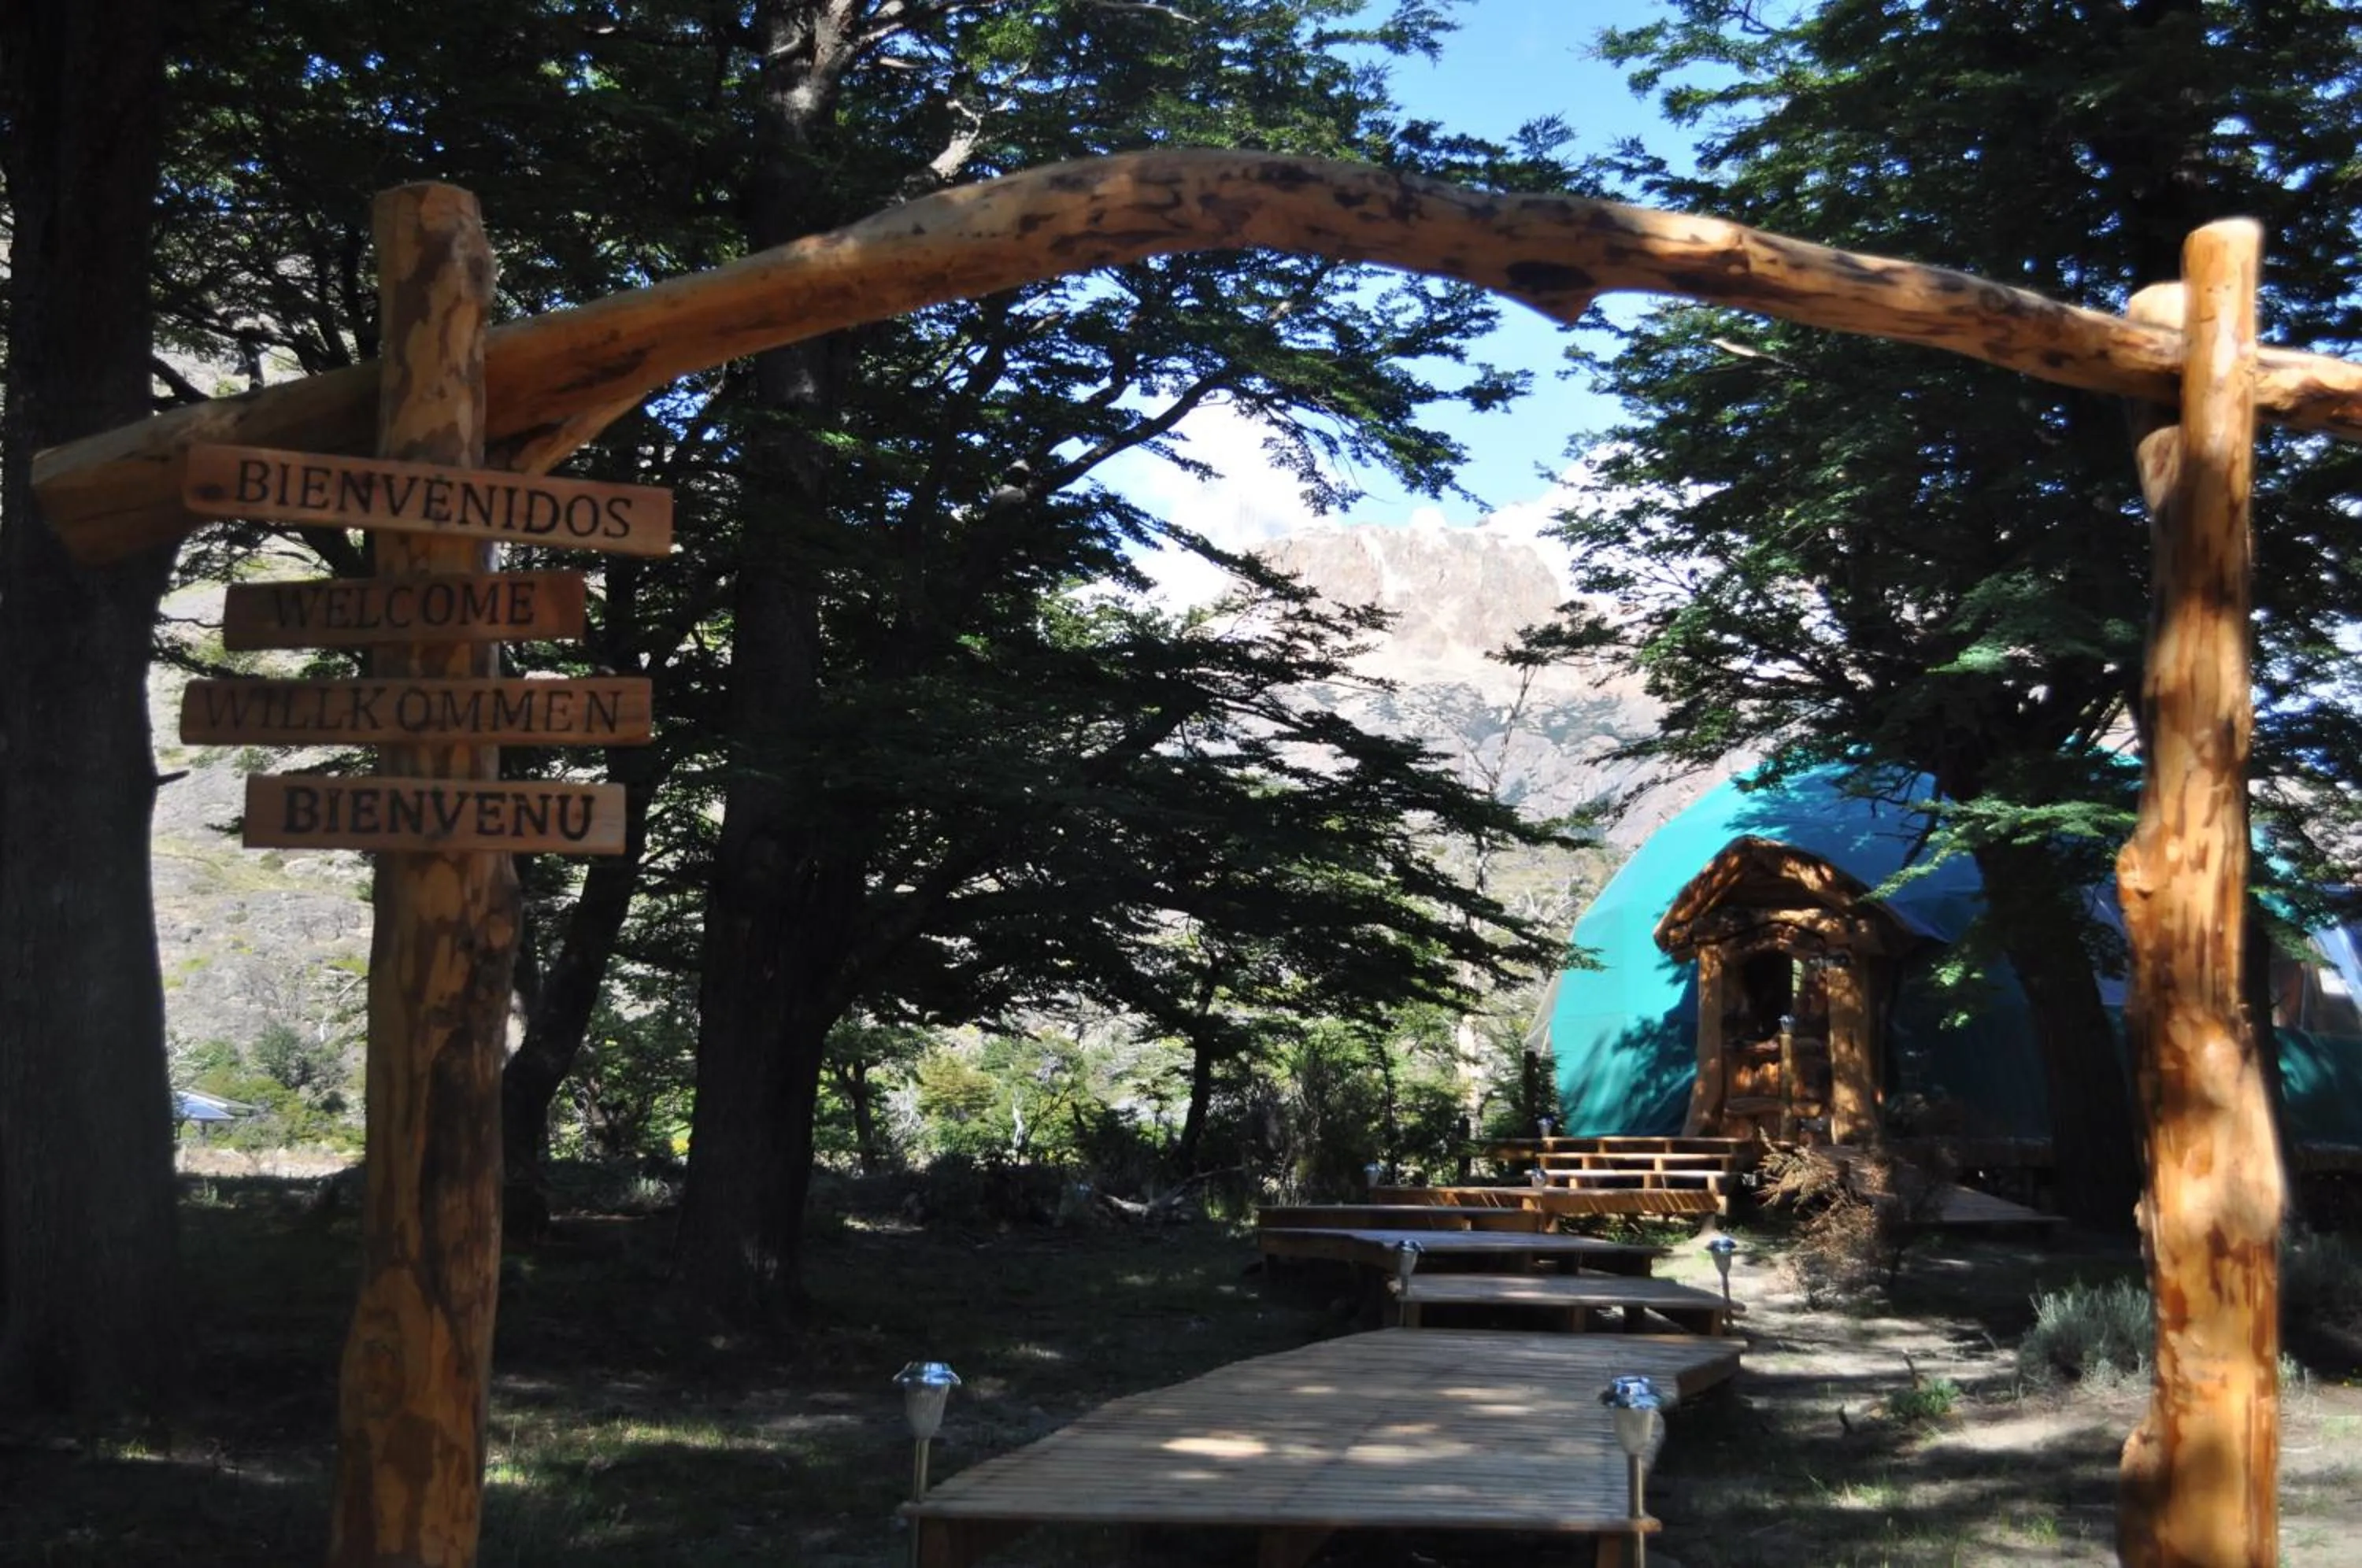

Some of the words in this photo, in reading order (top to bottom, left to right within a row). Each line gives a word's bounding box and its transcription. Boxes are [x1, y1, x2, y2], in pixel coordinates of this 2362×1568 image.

[235, 458, 633, 539] BIENVENIDOS
[273, 581, 536, 630] WELCOME
[202, 686, 624, 734] WILLKOMMEN
[283, 787, 595, 841] BIENVENU
